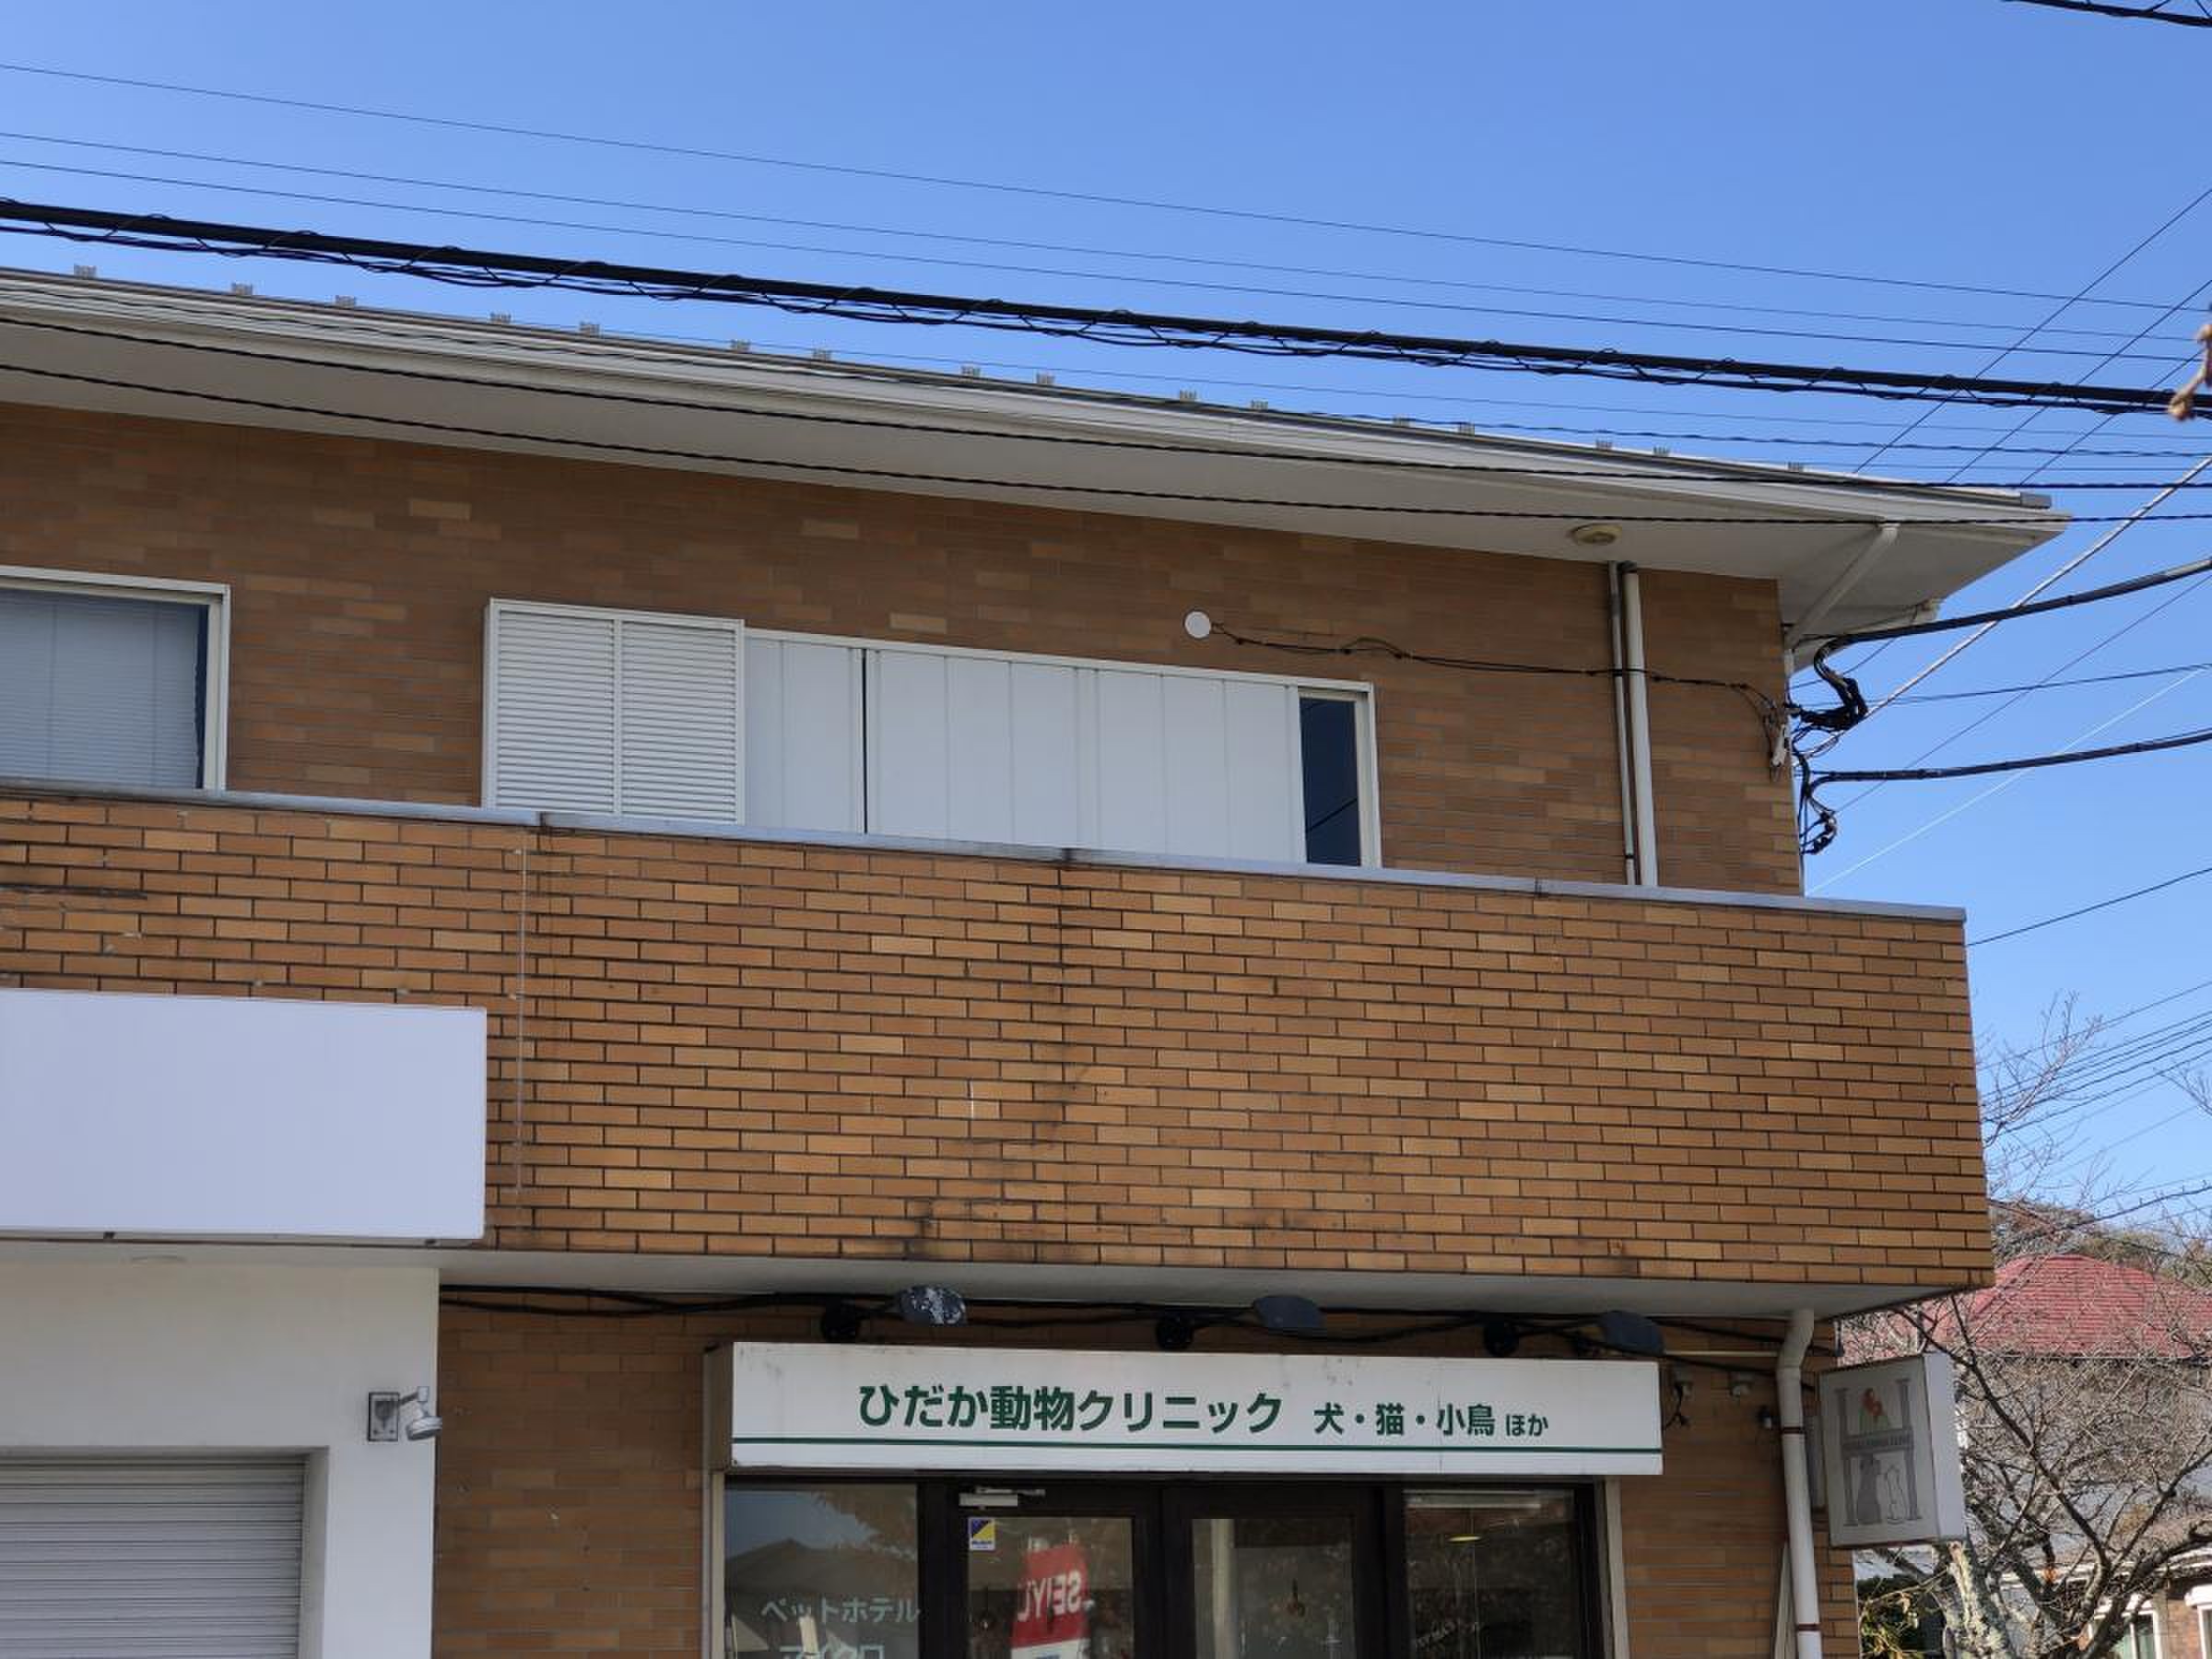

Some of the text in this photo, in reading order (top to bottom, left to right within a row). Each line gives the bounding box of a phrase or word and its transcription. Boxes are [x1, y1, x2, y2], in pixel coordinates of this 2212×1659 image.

[859, 1383, 1549, 1436] ひだか動物クリニック 犬・猫・小鳥 ほか
[761, 1597, 921, 1623] ペットホテル
